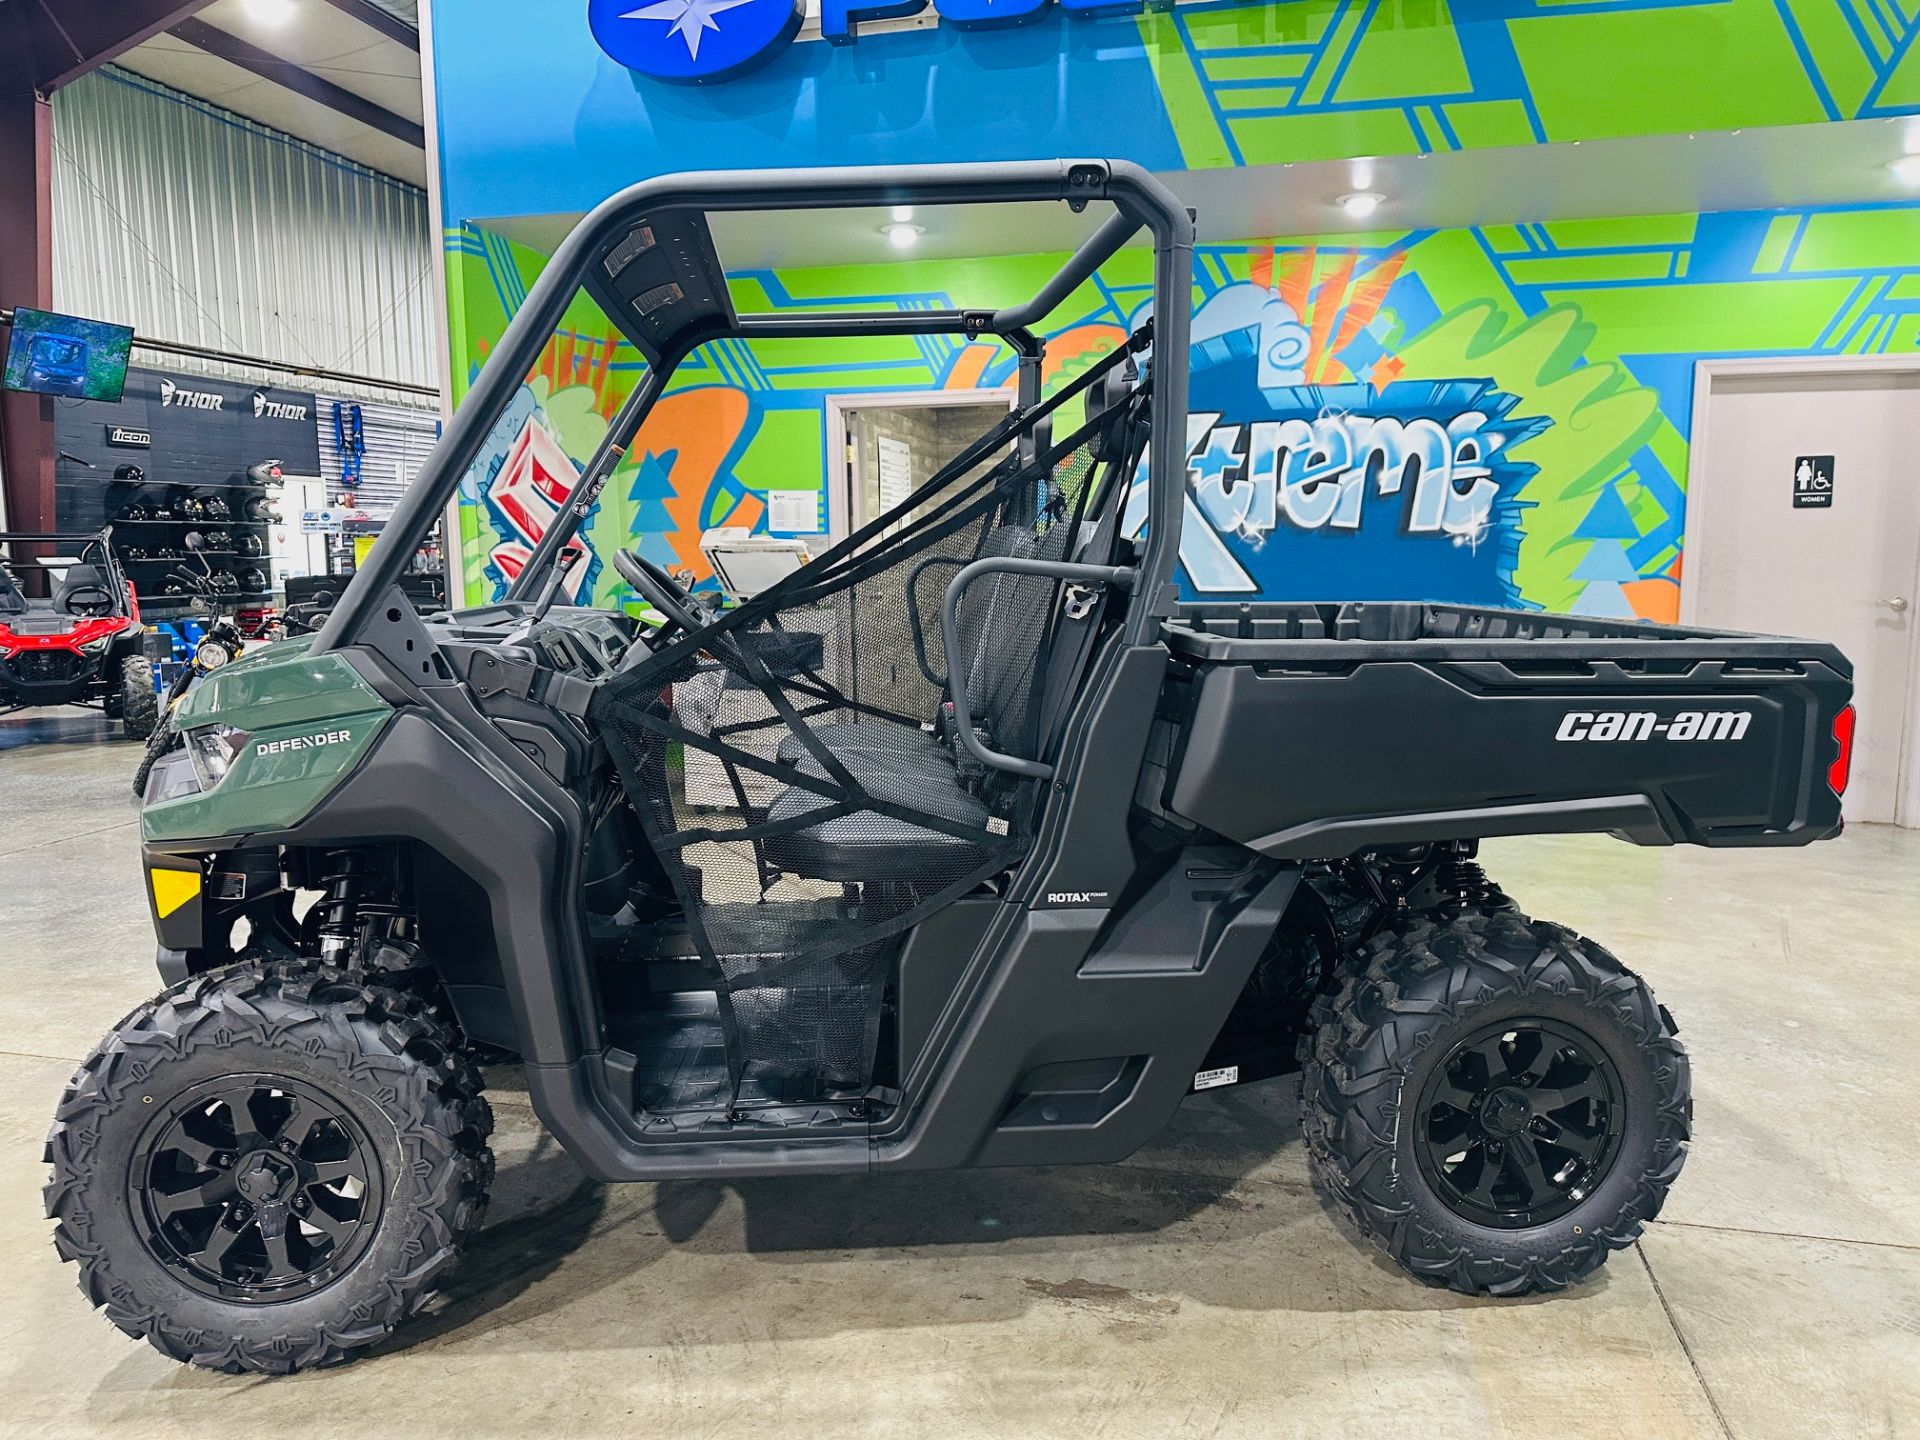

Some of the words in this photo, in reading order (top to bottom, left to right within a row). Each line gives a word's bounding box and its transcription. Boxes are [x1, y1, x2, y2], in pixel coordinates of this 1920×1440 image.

[175, 390, 224, 411] THOR
[266, 402, 307, 421] THOR
[257, 730, 351, 756] DEFENDER
[1047, 892, 1090, 903] ROTAX
